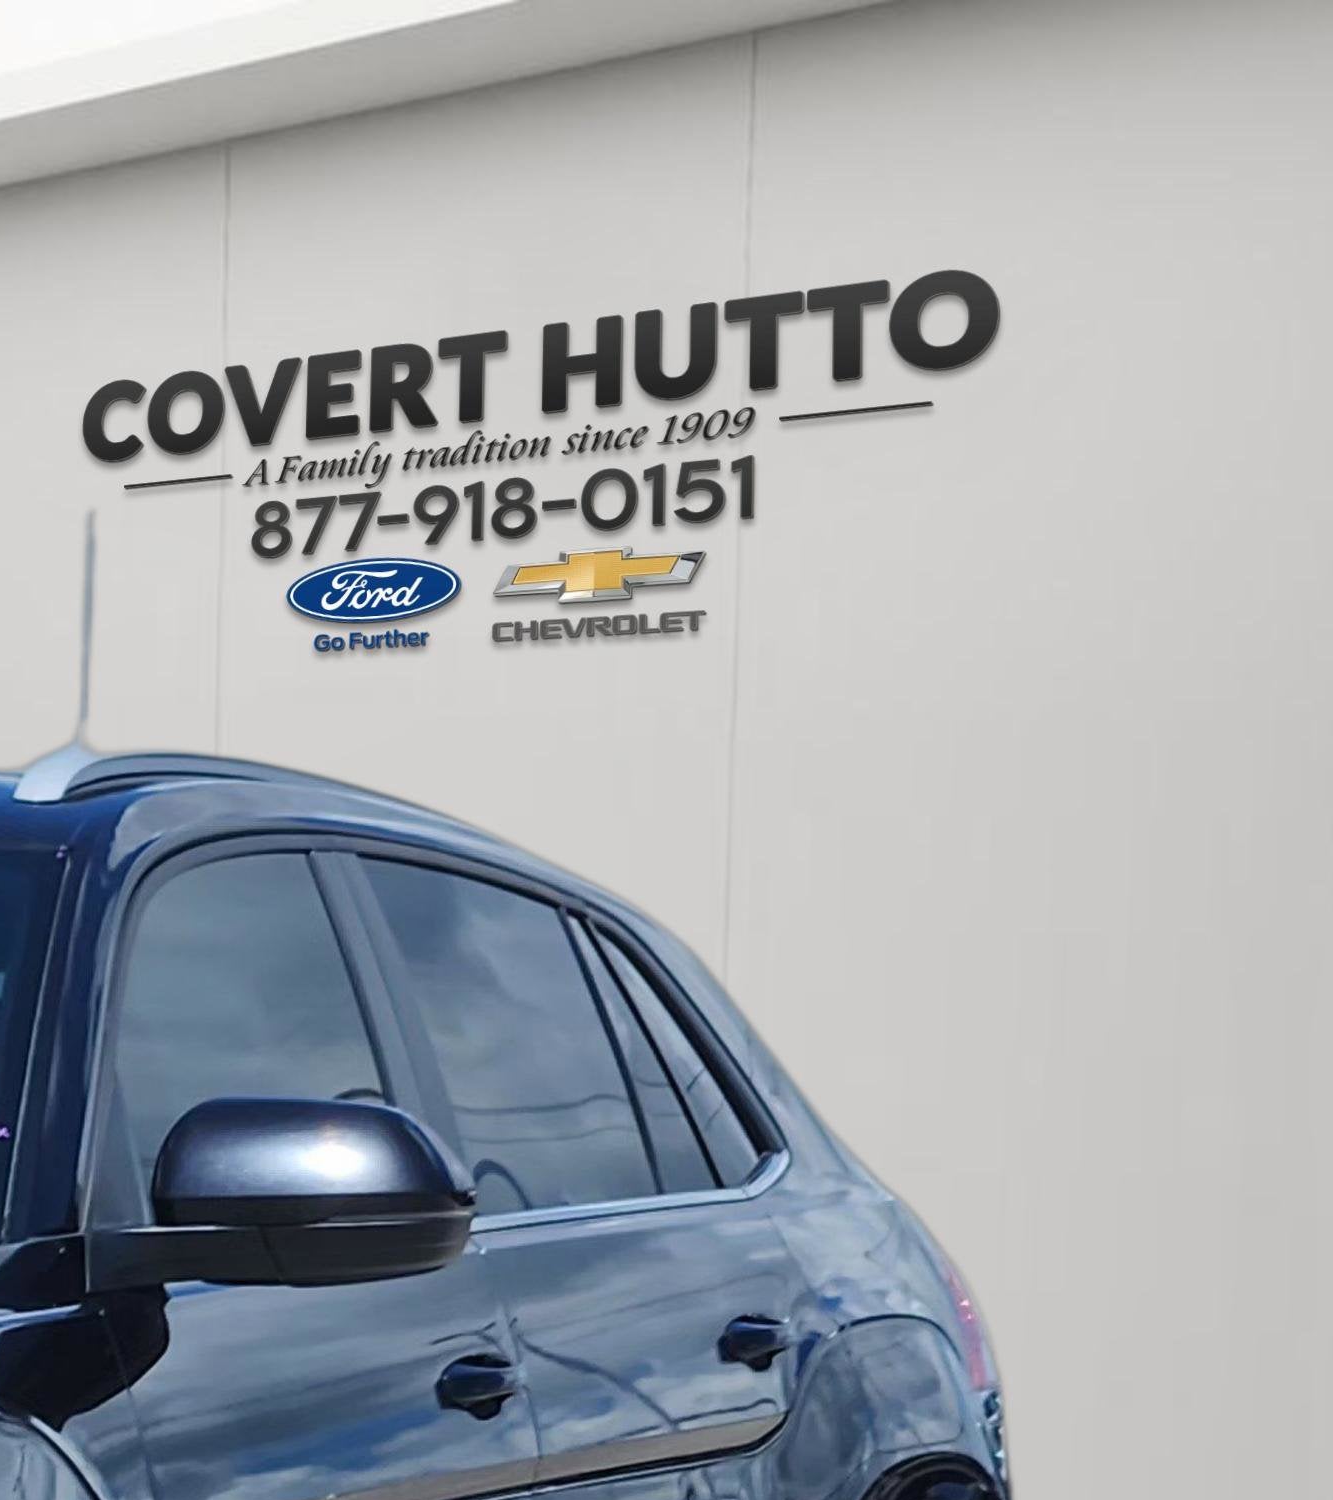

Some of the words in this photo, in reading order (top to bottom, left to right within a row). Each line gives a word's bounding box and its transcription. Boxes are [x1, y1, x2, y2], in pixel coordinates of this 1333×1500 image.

[82, 331, 509, 463] COVERT
[541, 269, 1001, 413] HUTTO
[242, 458, 269, 487] A
[275, 441, 392, 489] Family
[402, 430, 552, 472] tradition
[561, 424, 649, 456] since
[656, 407, 756, 445] 1909
[251, 455, 755, 559] 877-918-0151
[320, 569, 422, 613] Ford
[313, 633, 345, 653] Go
[349, 629, 429, 650] Further
[491, 609, 707, 643] CHEVROLET
